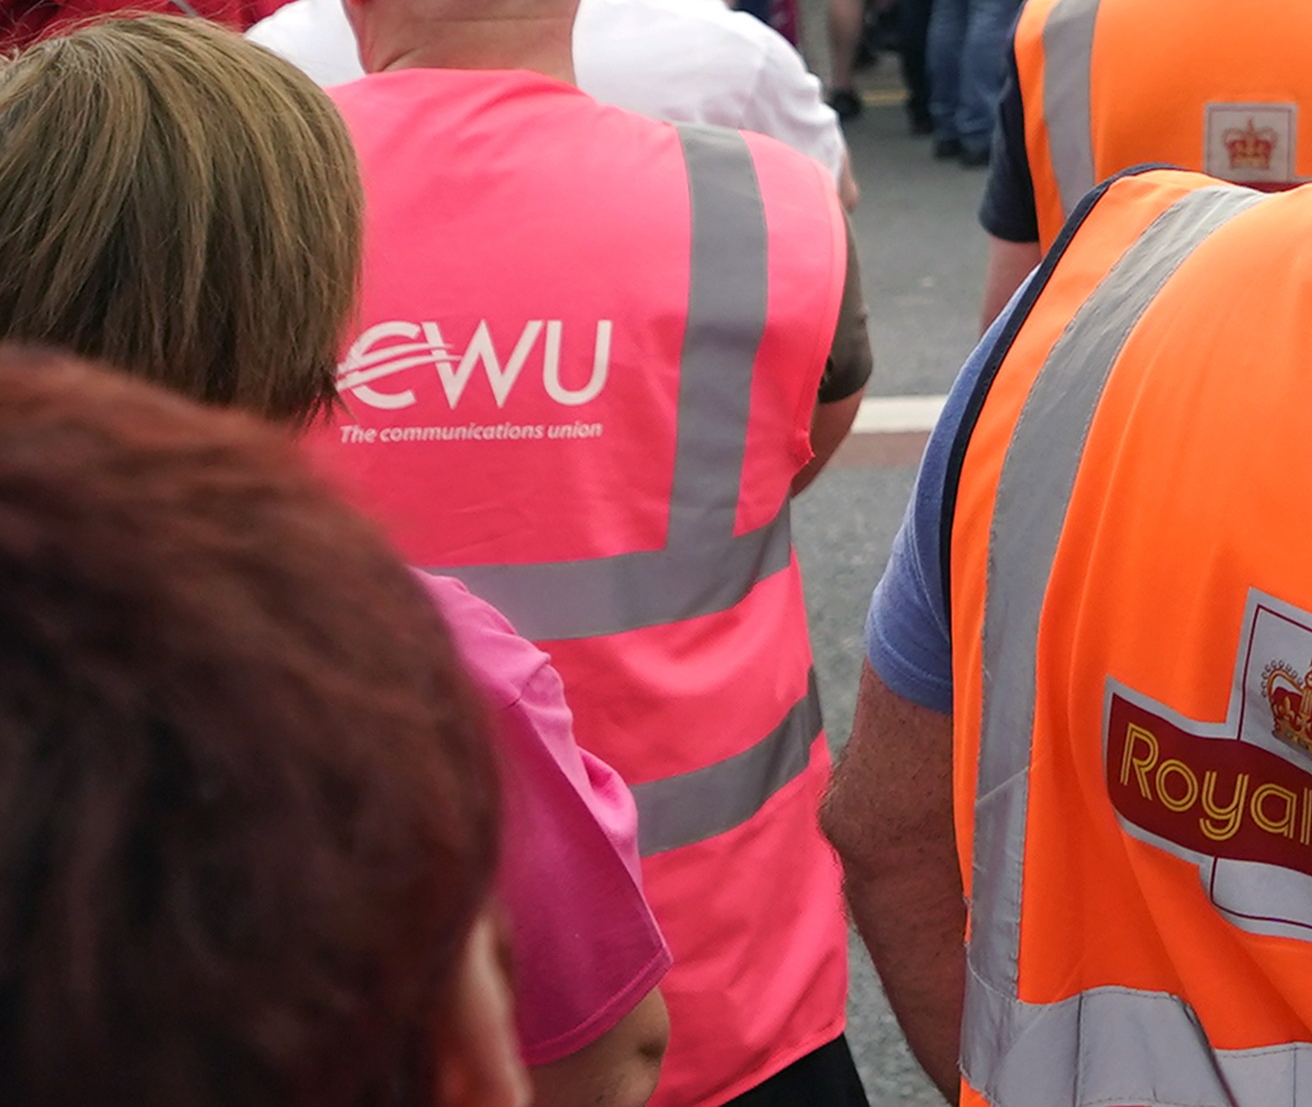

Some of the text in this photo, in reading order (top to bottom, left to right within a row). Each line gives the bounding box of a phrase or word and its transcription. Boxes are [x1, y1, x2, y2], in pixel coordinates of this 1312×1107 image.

[337, 319, 613, 410] CWU
[340, 419, 603, 444] The communications union
[1119, 721, 1312, 846] Royal
